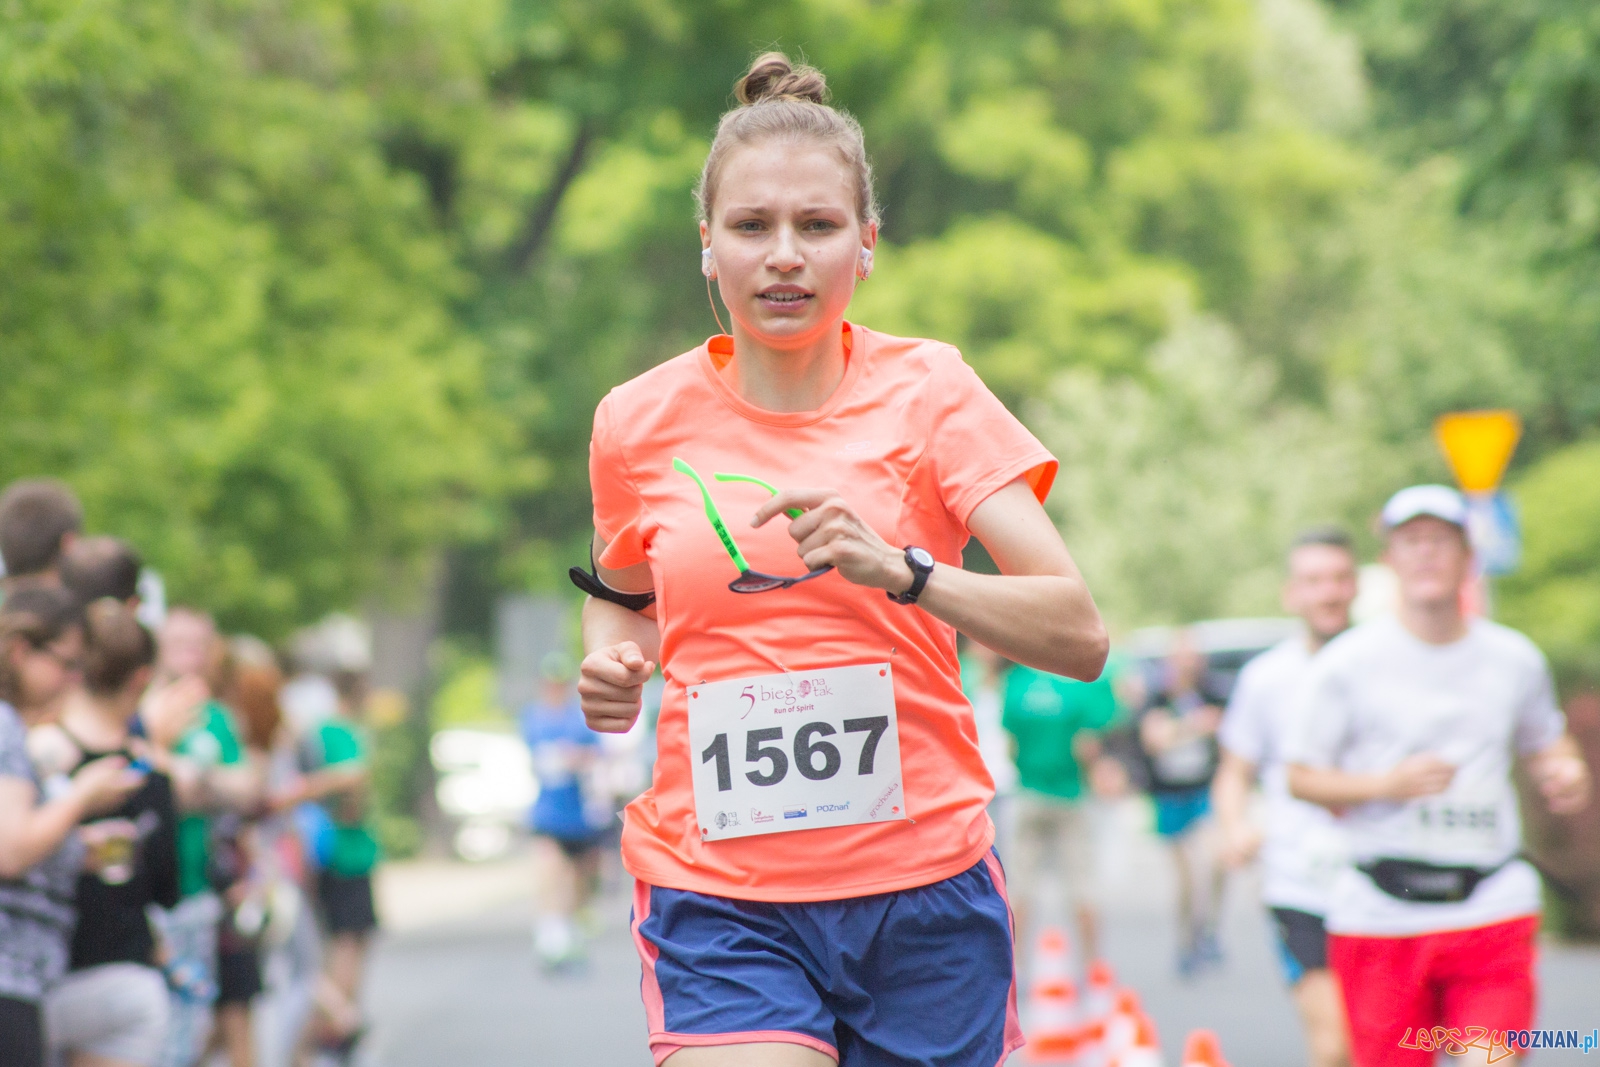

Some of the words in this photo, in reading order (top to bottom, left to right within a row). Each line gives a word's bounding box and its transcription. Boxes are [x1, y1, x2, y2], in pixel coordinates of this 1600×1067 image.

[812, 678, 826, 686] na
[813, 685, 834, 697] tak
[740, 685, 755, 720] 5
[761, 685, 797, 706] bieg
[796, 704, 815, 714] Spirit
[702, 715, 889, 792] 1567
